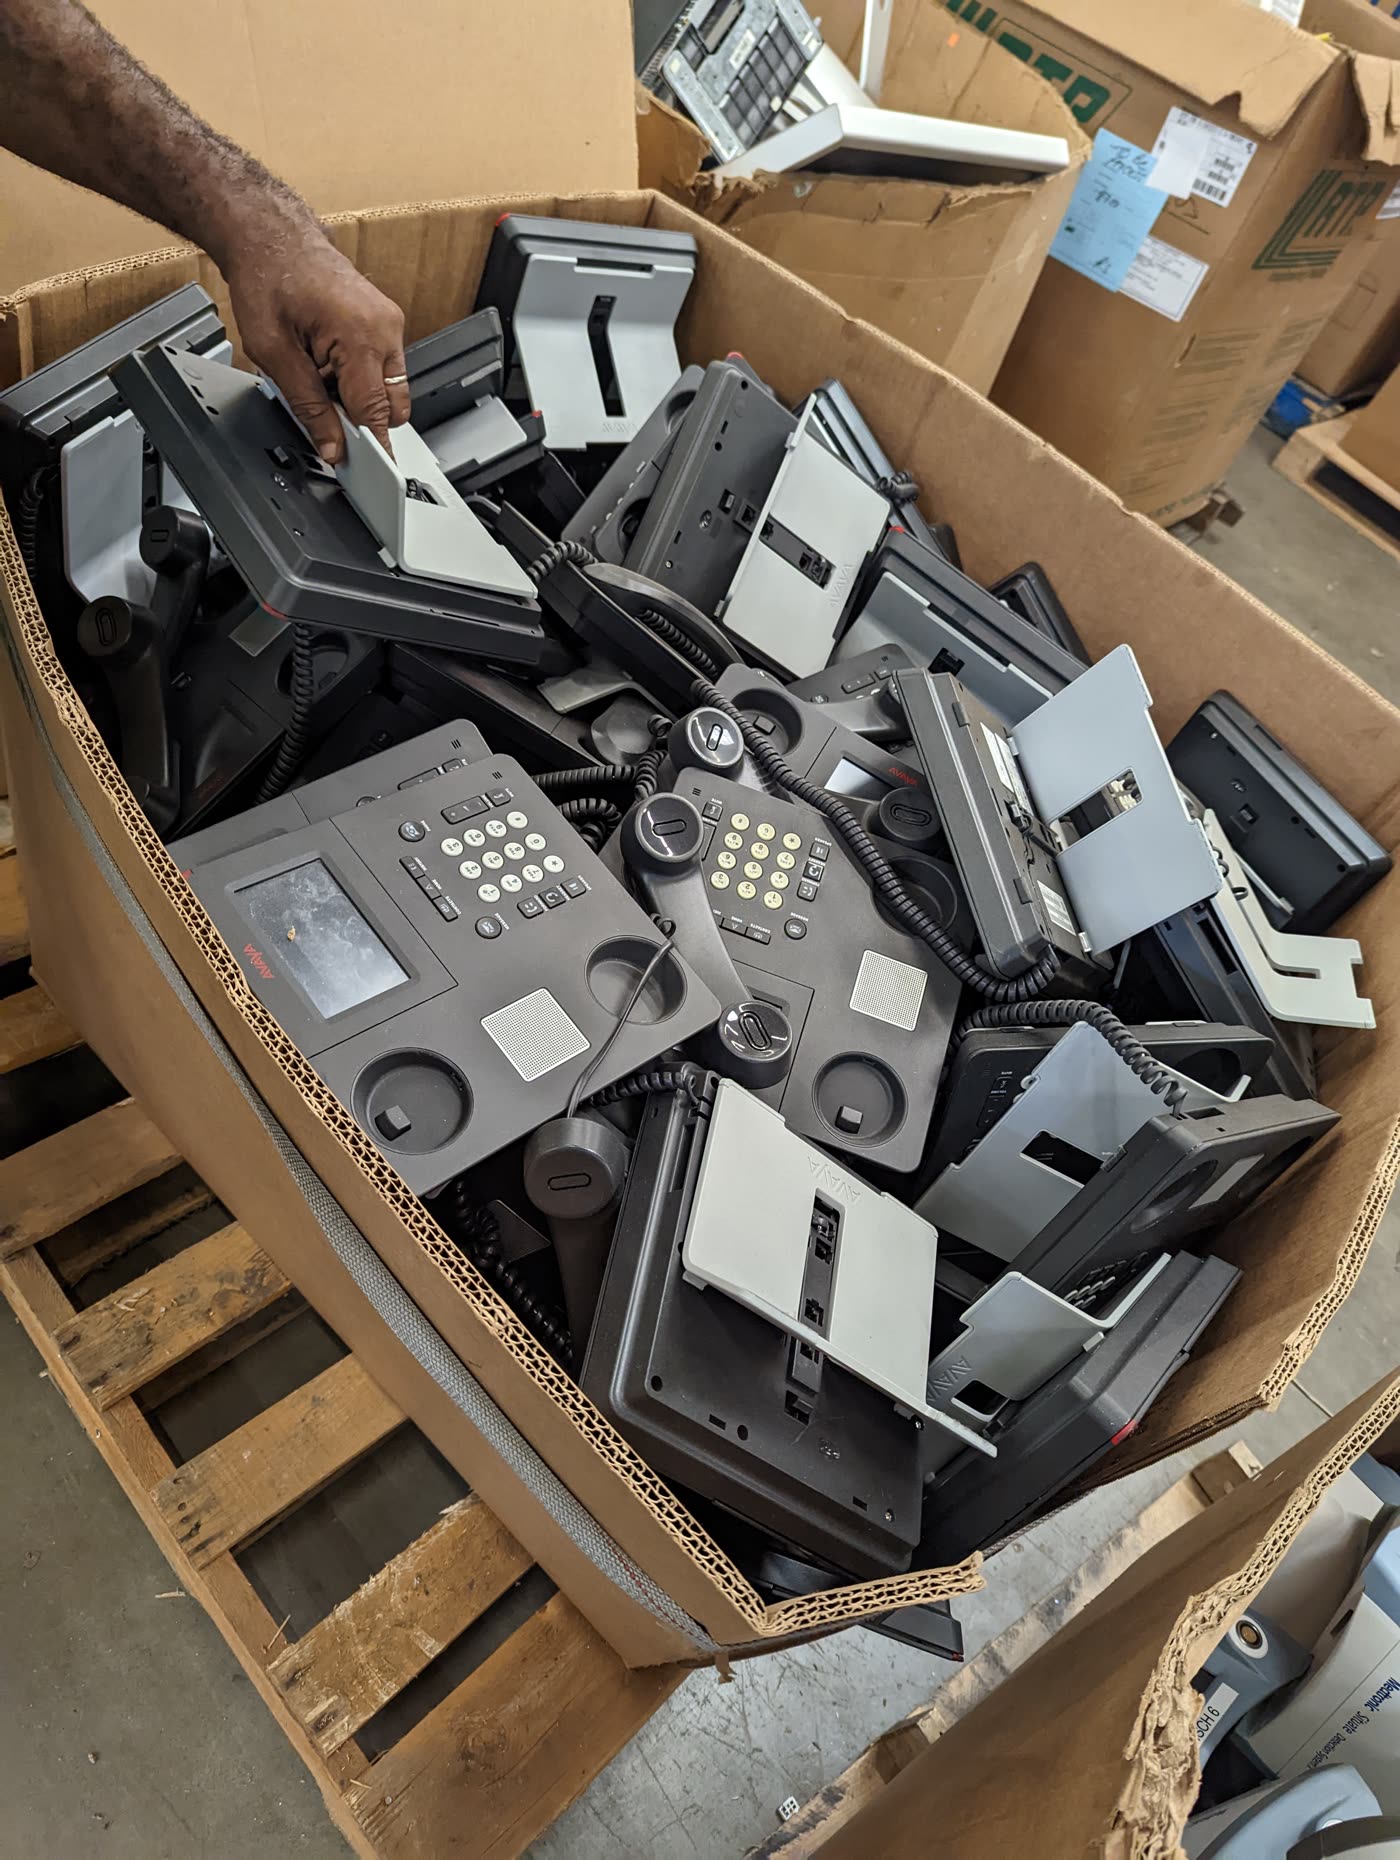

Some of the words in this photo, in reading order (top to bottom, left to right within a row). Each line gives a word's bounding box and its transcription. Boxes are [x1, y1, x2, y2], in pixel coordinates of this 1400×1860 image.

[243, 943, 274, 979] AVAYA
[807, 1155, 861, 1202] AVAYA
[1364, 1676, 1400, 1712] Medtronic
[1196, 1712, 1216, 1741] SCH
[1207, 1705, 1220, 1717] 6
[1342, 1711, 1370, 1734] Situate
[1322, 1731, 1347, 1752] Detection
